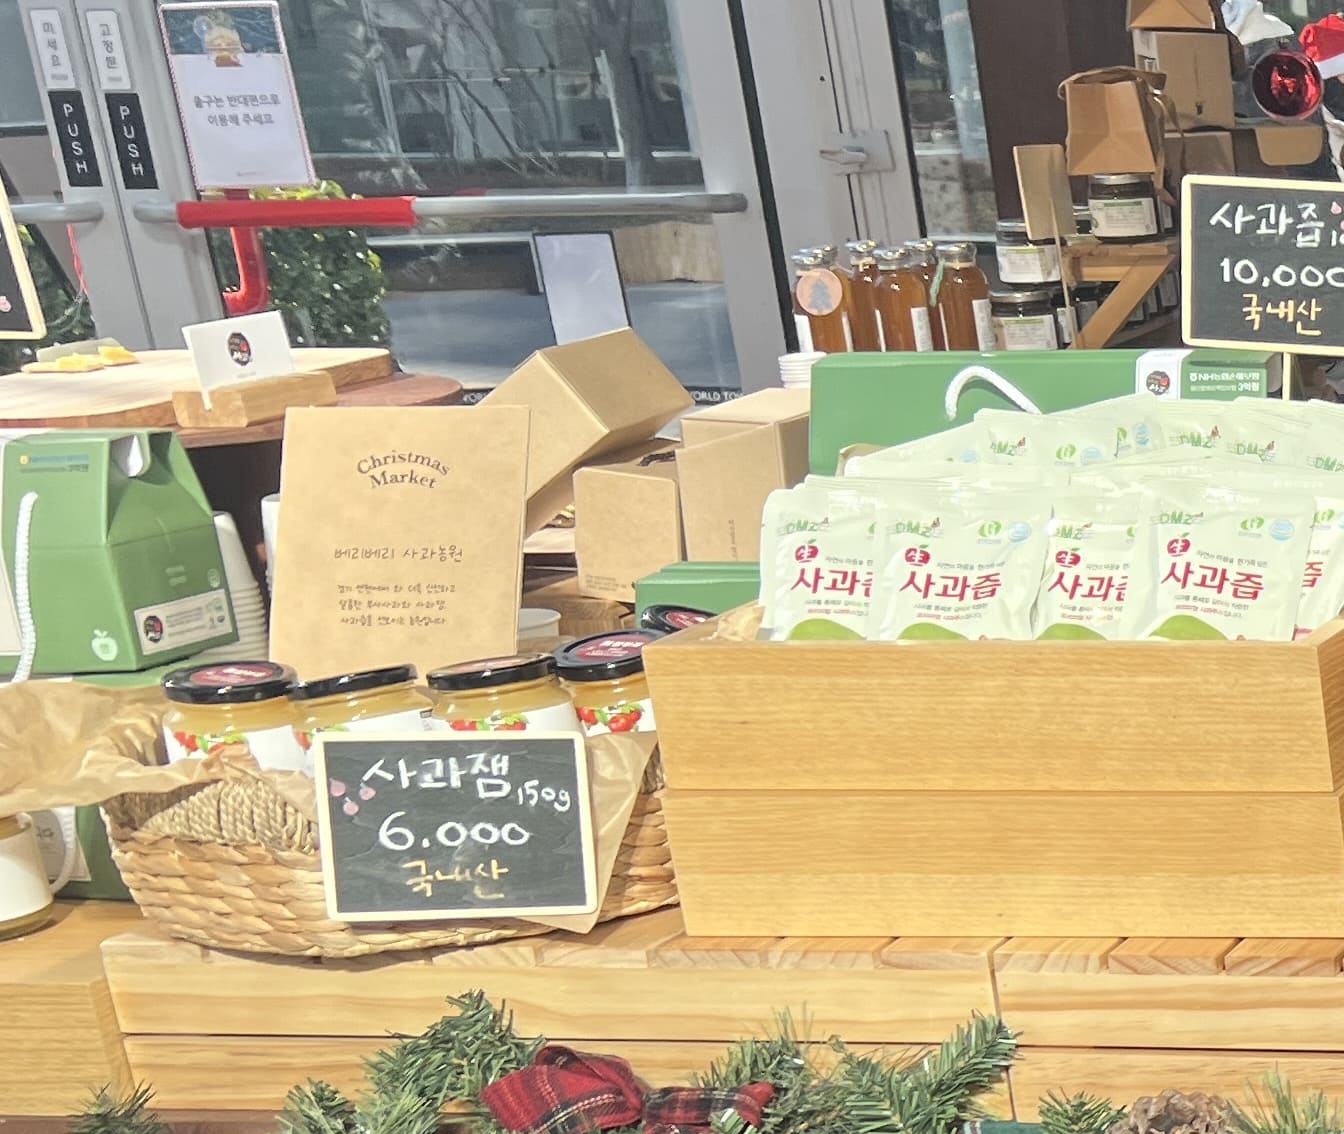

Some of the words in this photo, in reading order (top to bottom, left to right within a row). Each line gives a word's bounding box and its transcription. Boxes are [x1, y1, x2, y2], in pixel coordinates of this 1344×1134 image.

[63, 103, 88, 174] PUSH
[119, 105, 144, 176] PUSH
[1210, 202, 1325, 248] 사과즙
[1242, 293, 1323, 336] 국내산
[692, 391, 720, 402] ORLD
[356, 450, 450, 476] Christmas
[370, 468, 437, 489] Market
[334, 547, 395, 560] 베리베리
[403, 544, 463, 563] 사과농원
[899, 570, 1002, 601] 사과즙
[1161, 561, 1264, 600] 사과즙
[362, 753, 511, 799] 사과잼
[517, 779, 571, 812] 150g
[402, 860, 509, 899] 국내산
